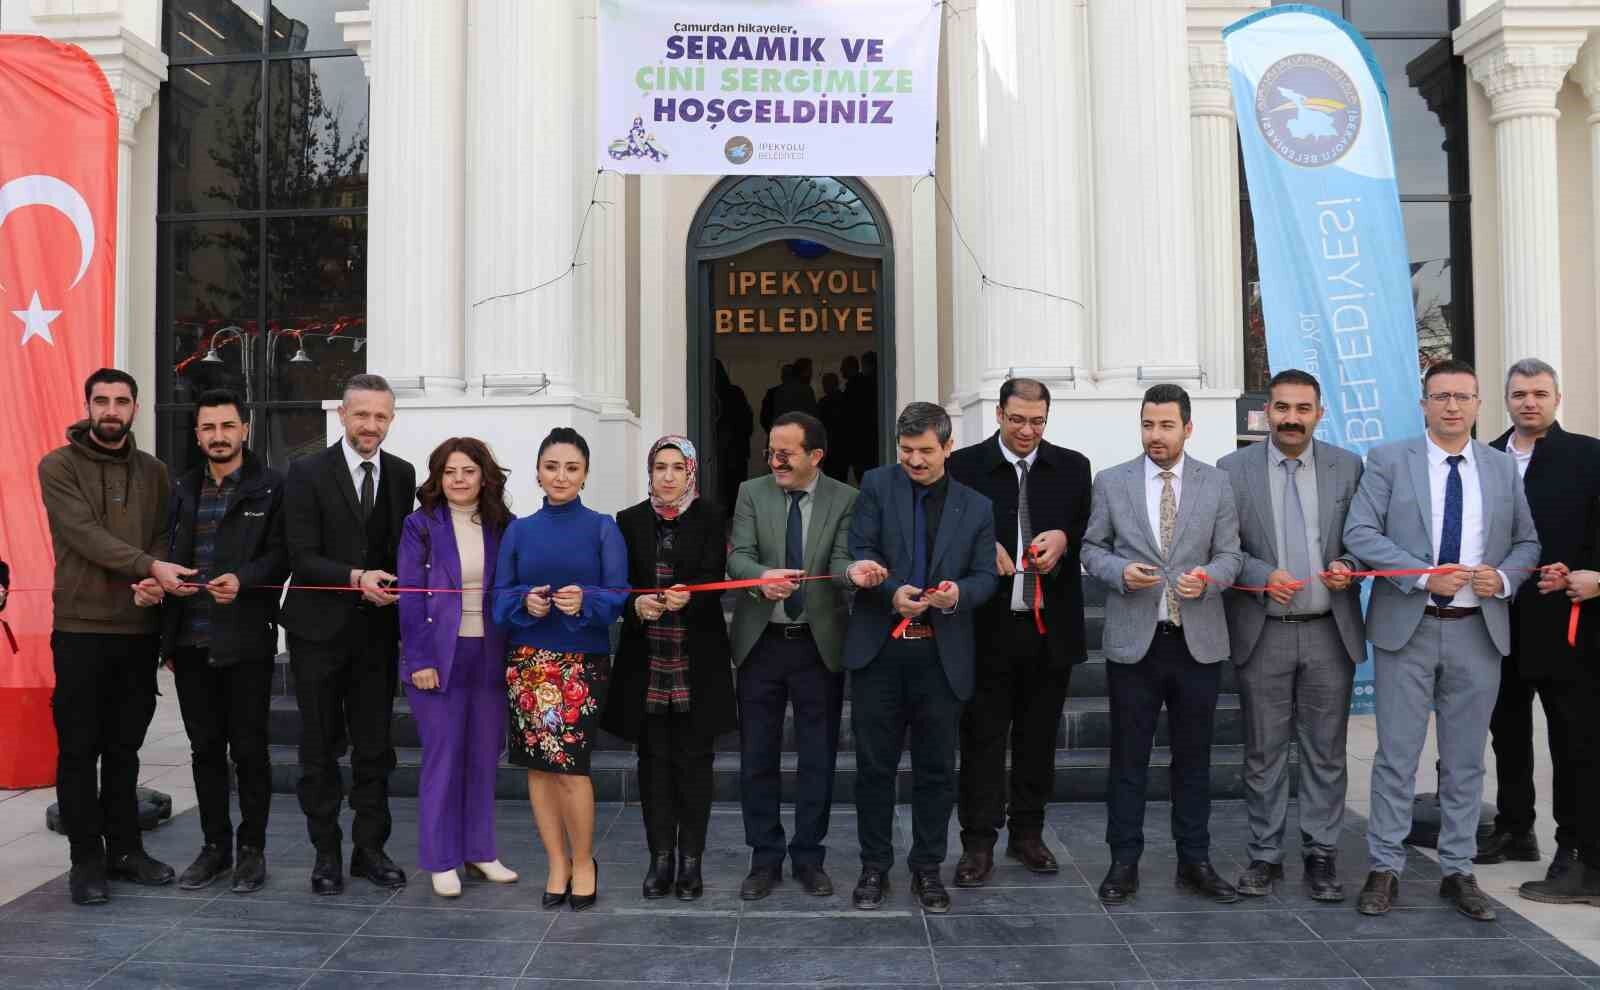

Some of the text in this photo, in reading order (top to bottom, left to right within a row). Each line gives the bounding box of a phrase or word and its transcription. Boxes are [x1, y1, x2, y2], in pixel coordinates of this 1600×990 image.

[665, 29, 884, 63] SERAMİK VE
[635, 60, 913, 97] ÇİNİ SERGİMİZE
[653, 93, 894, 130] HOŞGELDİNİZ
